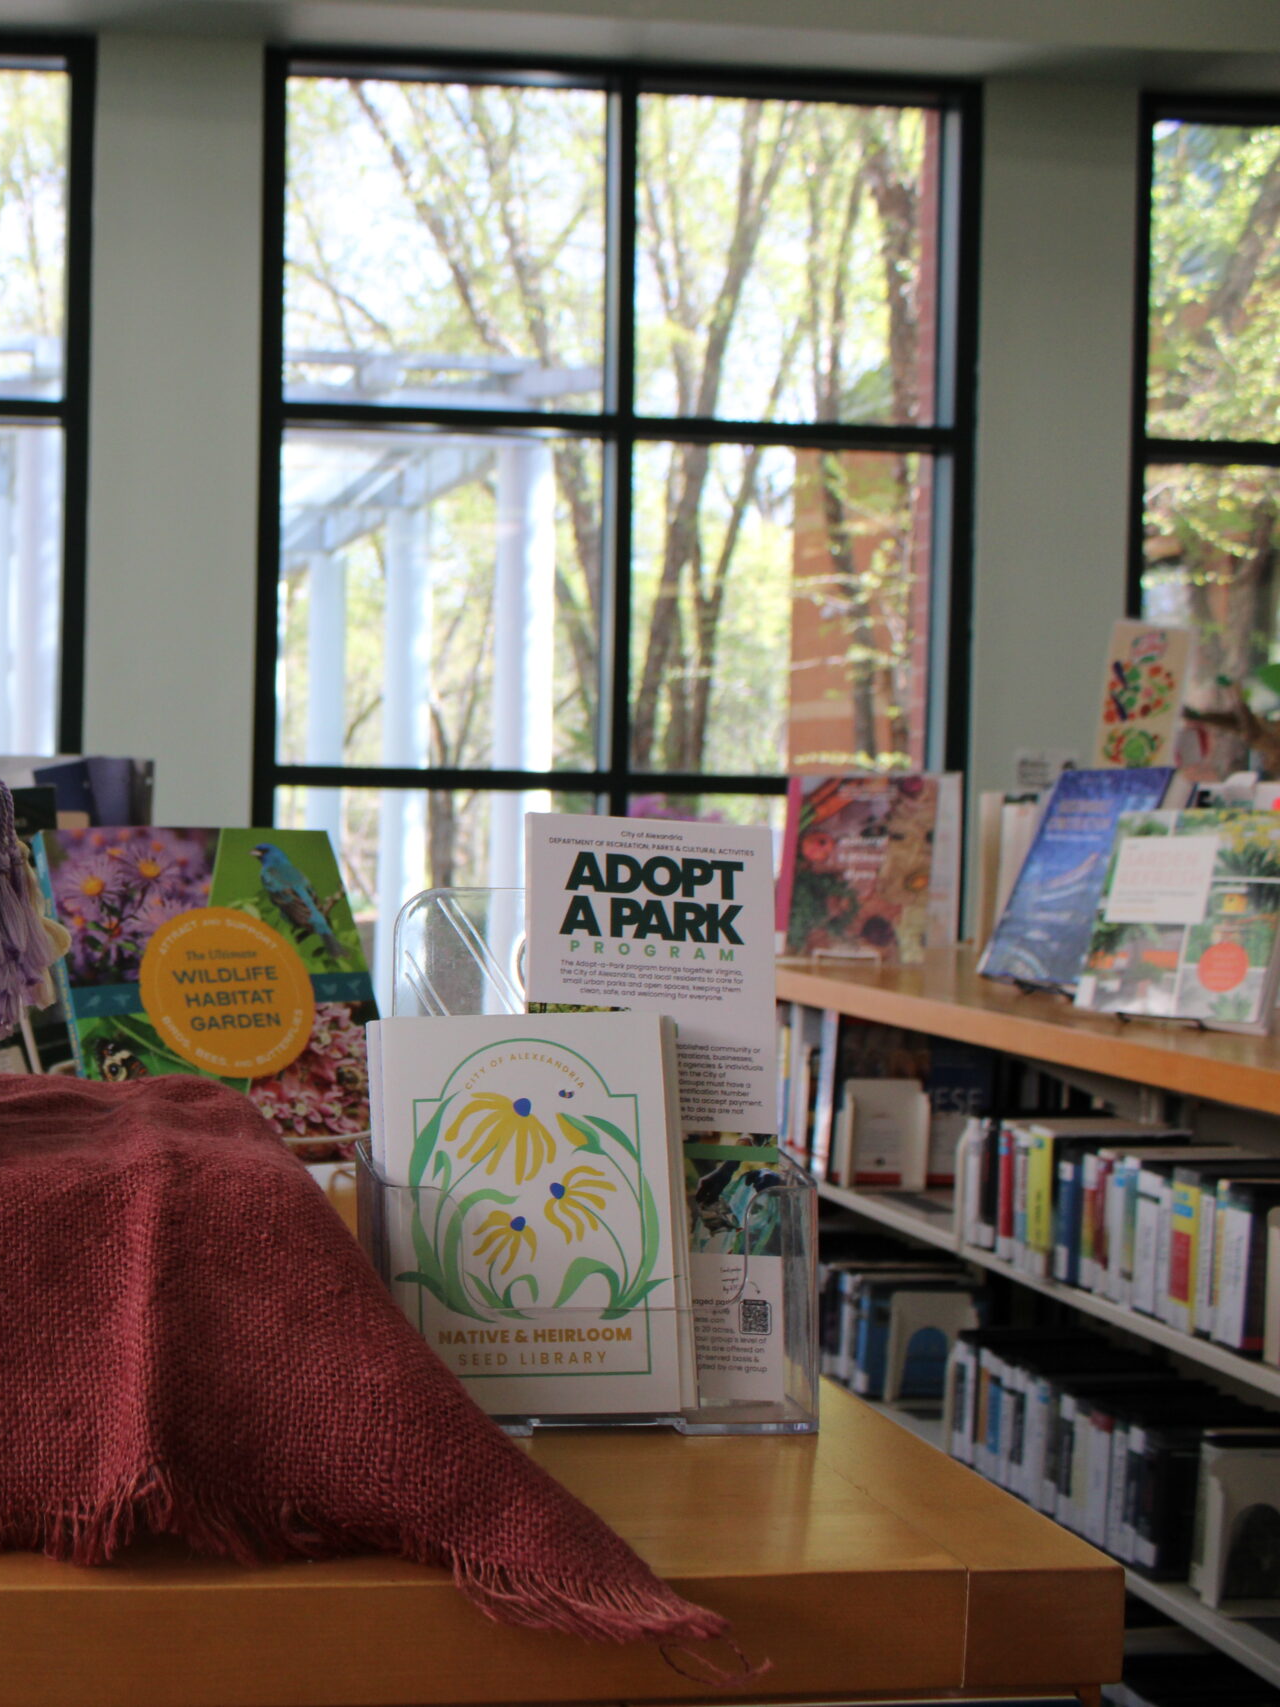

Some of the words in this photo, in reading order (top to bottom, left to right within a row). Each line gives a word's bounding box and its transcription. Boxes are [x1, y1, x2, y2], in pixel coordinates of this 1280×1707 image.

[621, 831, 635, 839] City
[645, 832, 683, 841] Alexandria
[549, 836, 594, 846] DEPARTMENT
[652, 843, 674, 851] PARKS
[682, 846, 716, 854] CULTURAL
[718, 848, 755, 857] ACTIVITIES
[565, 851, 744, 900] ADOPT
[559, 895, 602, 937] A
[610, 897, 745, 945] PARK
[226, 919, 278, 949] SUPPORT
[185, 951, 205, 961] The
[208, 950, 258, 960] Ultimate
[570, 940, 736, 962] PROGRAM
[172, 965, 279, 984] WILDLIFE
[575, 960, 624, 969] Adopt-a-Park
[626, 964, 658, 972] program
[185, 989, 275, 1008] HABITAT
[638, 991, 676, 1000] welcoming
[692, 985, 720, 994] keeping
[190, 1012, 282, 1032] GARDEN
[711, 1045, 751, 1054] community
[464, 1066, 487, 1091] CITY
[490, 1055, 505, 1068] OF
[510, 1053, 586, 1089] ALEXEANDRIA
[683, 1063, 716, 1071] agencies
[725, 1063, 764, 1072] individuals
[701, 1098, 727, 1106] accept
[438, 1330, 510, 1345] NATIVE
[514, 1329, 528, 1344] &
[533, 1327, 633, 1343] HEIRLOOM
[458, 1353, 508, 1366] SEED
[520, 1351, 607, 1366] LIBRARY
